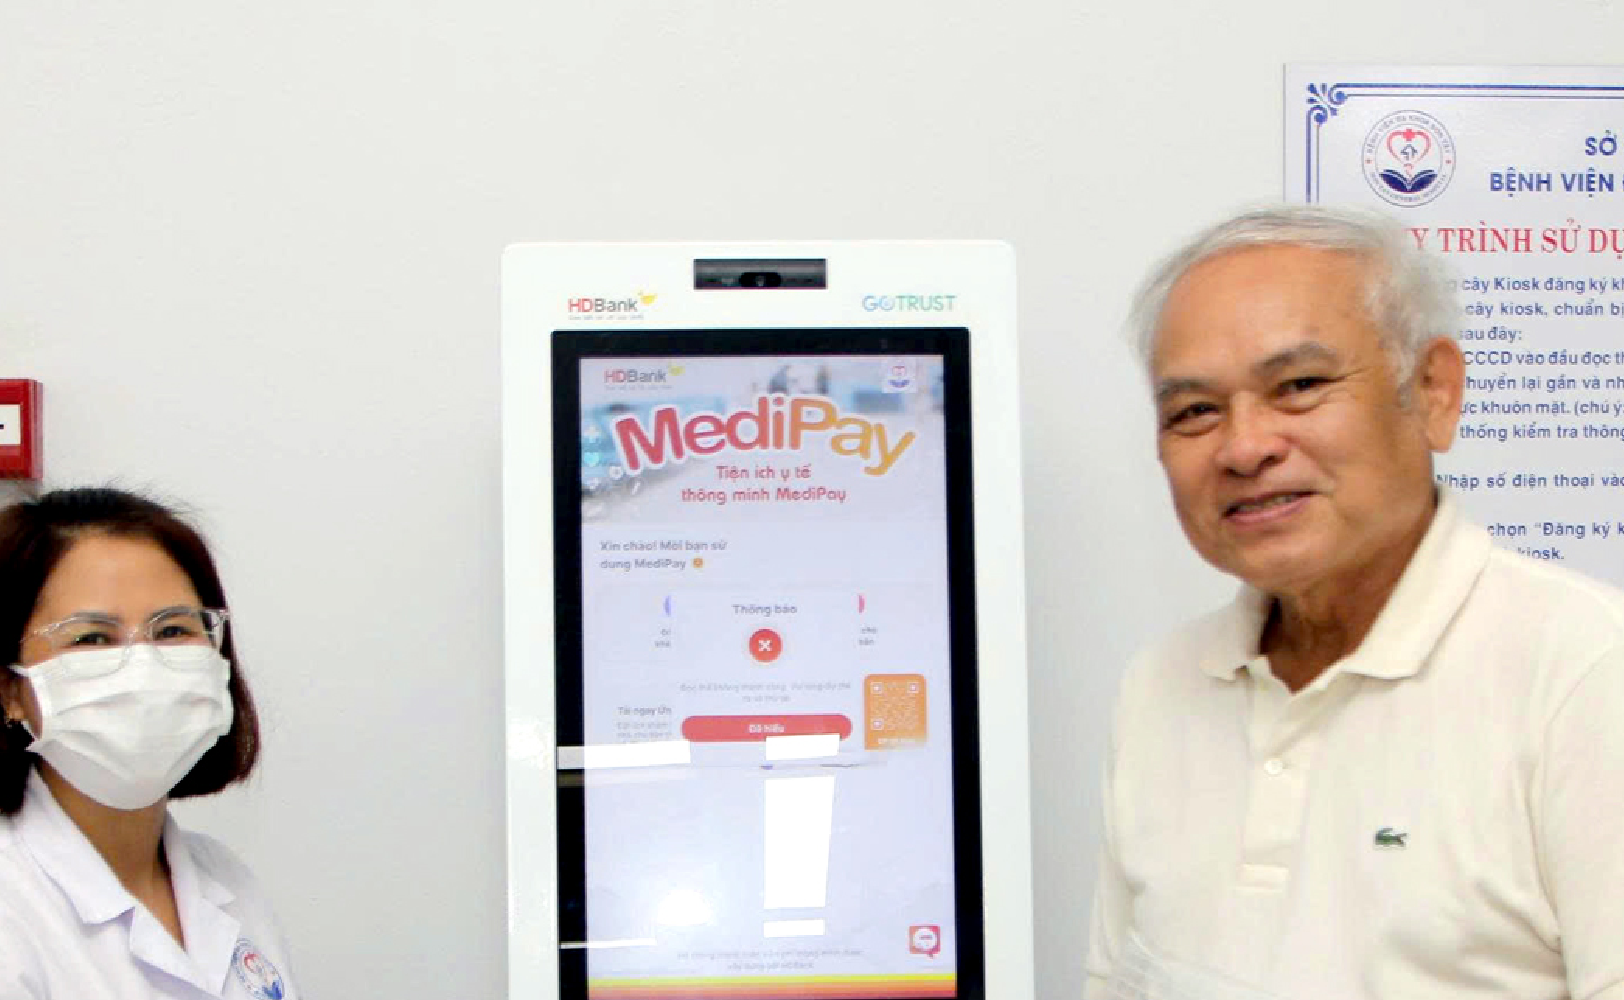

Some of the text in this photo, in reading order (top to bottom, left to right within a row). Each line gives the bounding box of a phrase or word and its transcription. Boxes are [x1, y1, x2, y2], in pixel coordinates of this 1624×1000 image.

[1584, 129, 1618, 157] SỞ
[1490, 166, 1553, 198] BỆNH
[1560, 166, 1615, 198] VIỆN
[1437, 221, 1533, 254] TRÌNH
[1540, 218, 1582, 254] SỬ
[1461, 275, 1491, 294] cây
[1493, 277, 1540, 291] Kiosk
[1543, 277, 1586, 296] đăng
[1588, 277, 1609, 294] ký
[567, 297, 639, 314] HDBank
[861, 294, 957, 313] GOTRUST
[1500, 302, 1548, 316] kiosk,
[1554, 297, 1604, 316] chuẩn
[1515, 351, 1545, 366] vào
[1548, 348, 1578, 366] đầu
[1580, 350, 1612, 366] đọc
[604, 368, 668, 385] HDBank
[614, 395, 917, 477] MediPay
[715, 464, 750, 481] Tiện
[681, 485, 847, 506] thông minh MediPay
[1591, 521, 1610, 540] ký
